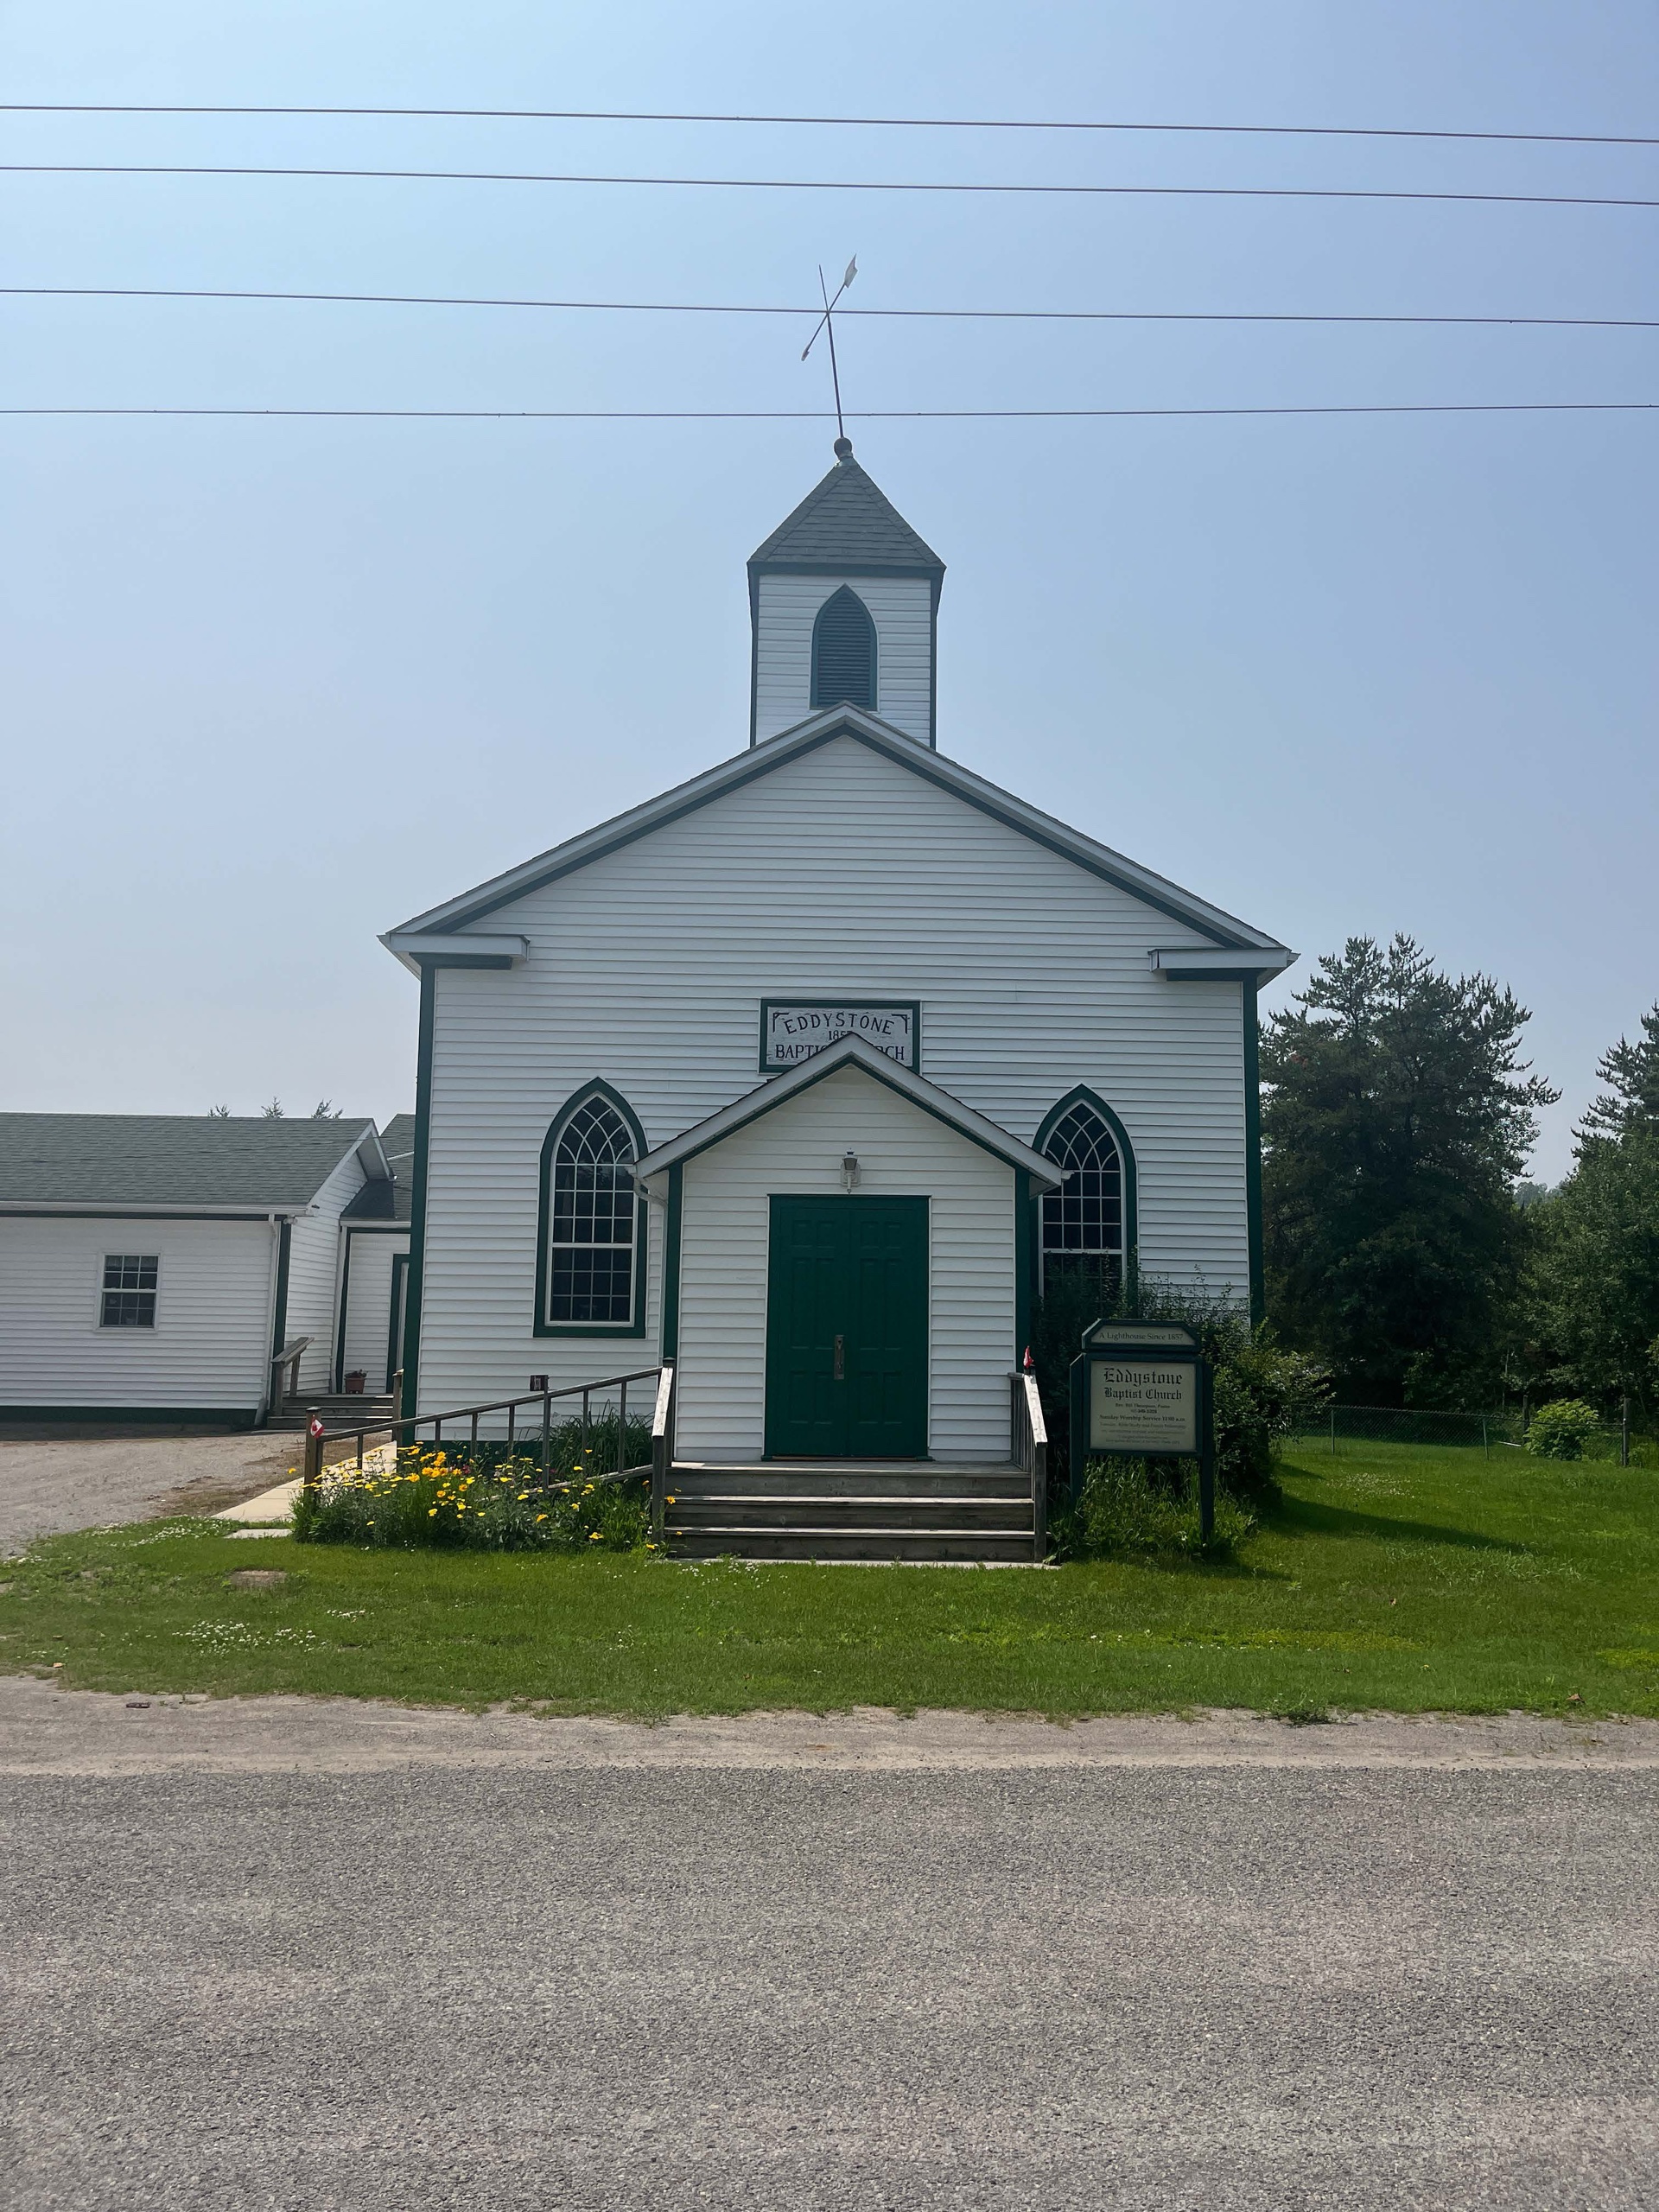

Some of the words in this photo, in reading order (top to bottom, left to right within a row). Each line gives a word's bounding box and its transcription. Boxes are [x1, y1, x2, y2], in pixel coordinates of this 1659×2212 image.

[784, 1013, 894, 1035] EDDYSTONE
[775, 1044, 828, 1058] BAPTI
[1107, 1332, 1147, 1340] Lighthouse
[1103, 1367, 1183, 1387] Eddystone
[1104, 1387, 1142, 1400] Baptist
[1145, 1389, 1182, 1402] Church
